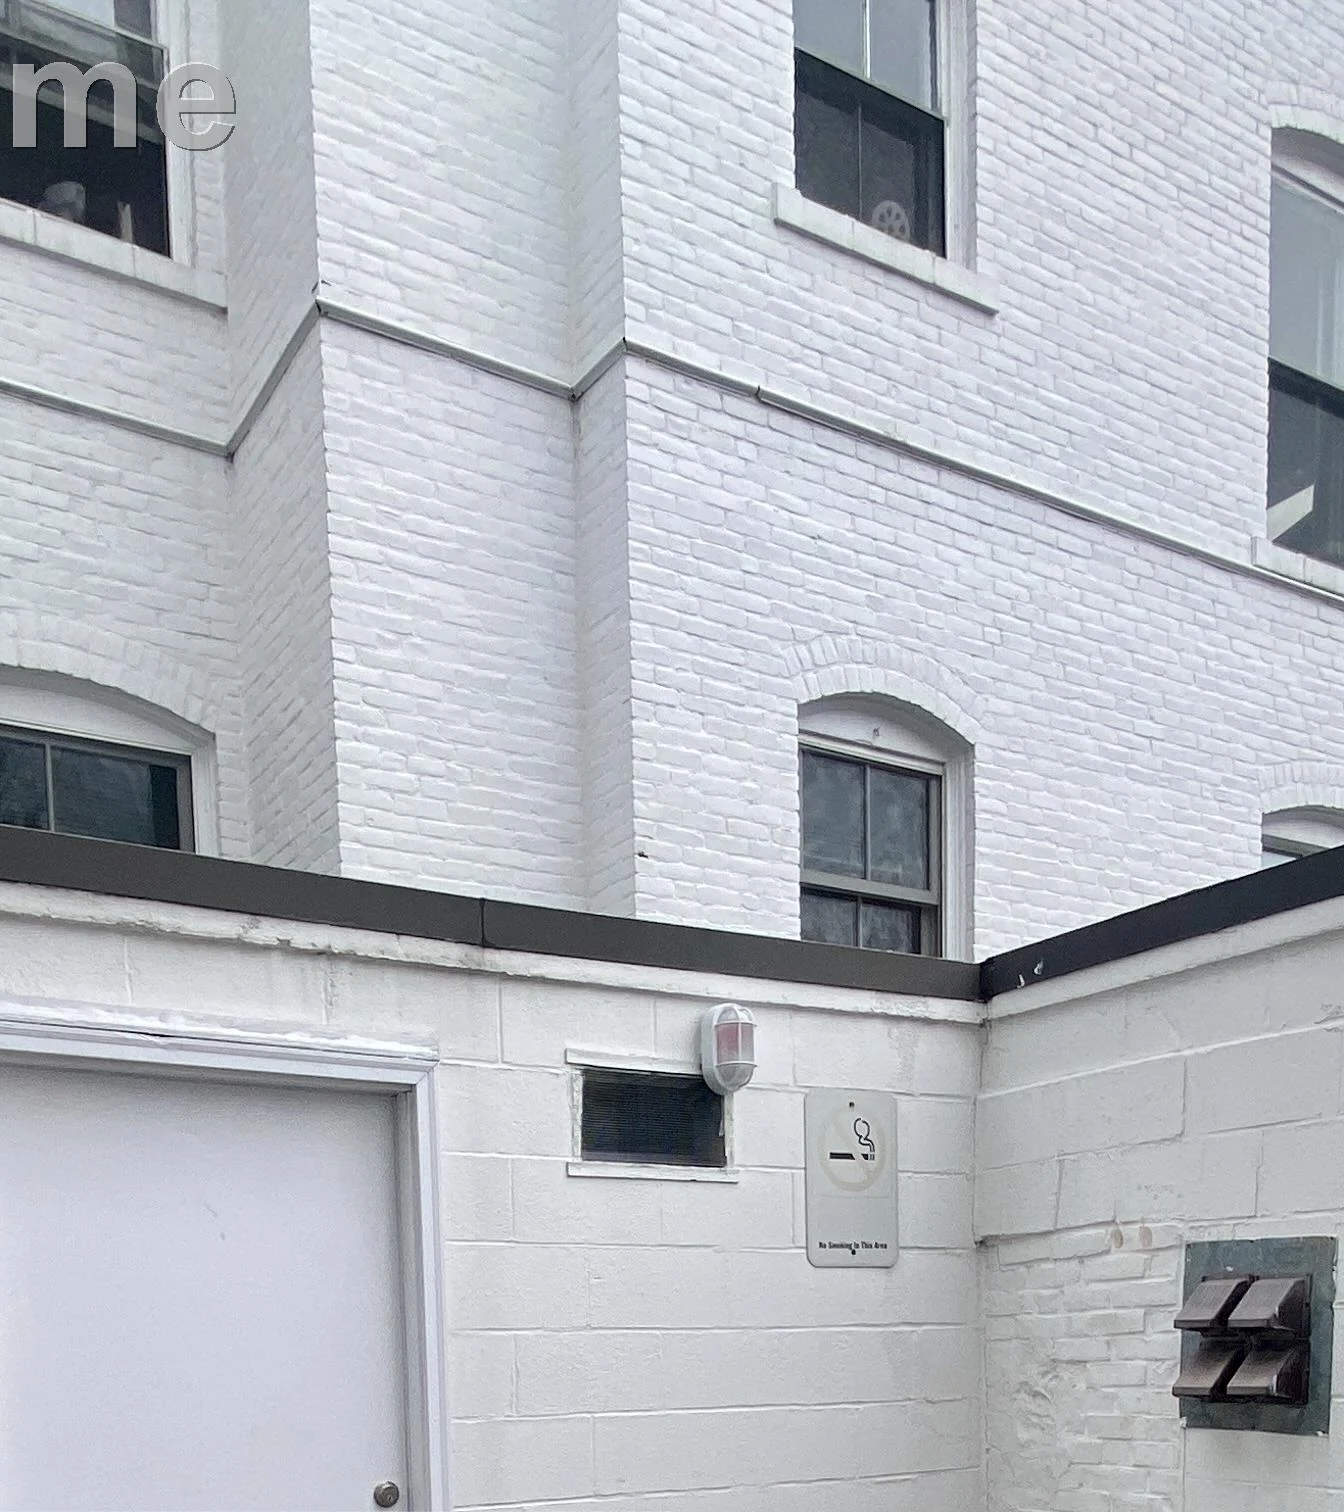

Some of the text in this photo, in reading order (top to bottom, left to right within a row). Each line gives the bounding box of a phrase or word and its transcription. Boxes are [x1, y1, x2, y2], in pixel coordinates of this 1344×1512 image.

[828, 1241, 853, 1251] Smoking
[860, 1241, 873, 1249] This
[874, 1241, 888, 1249] Area
